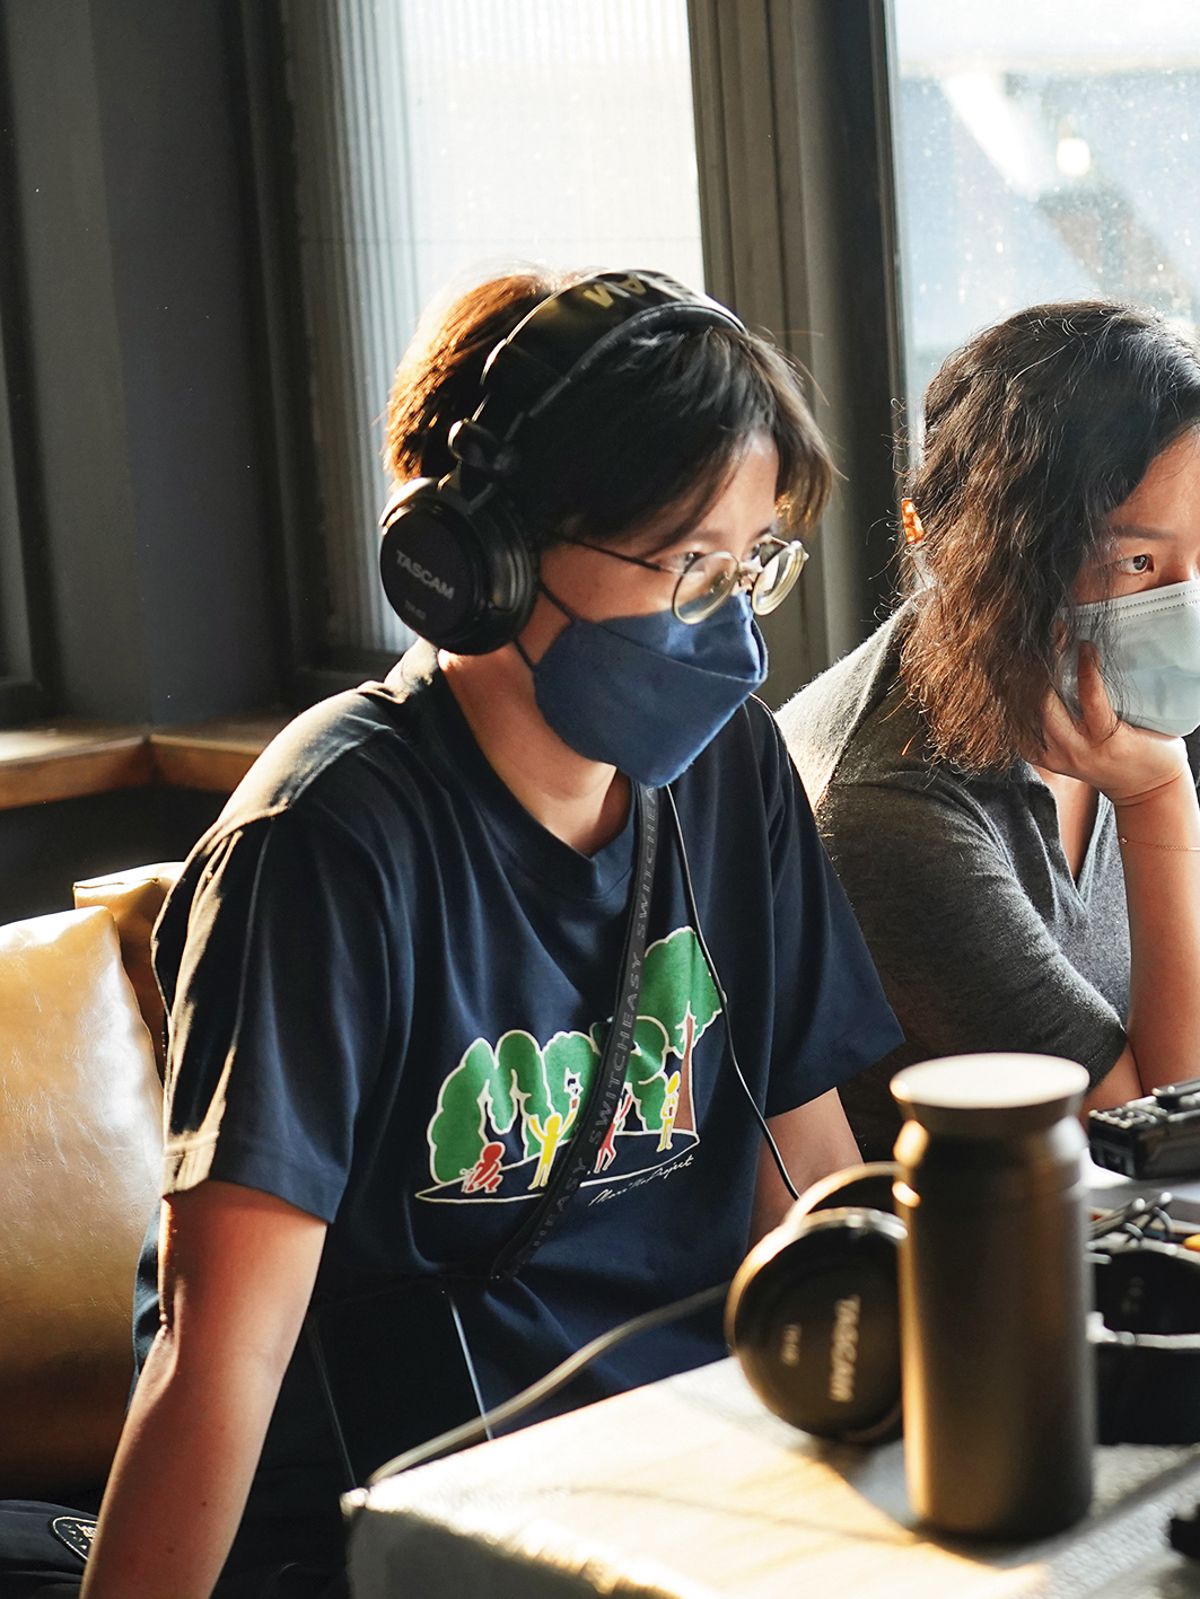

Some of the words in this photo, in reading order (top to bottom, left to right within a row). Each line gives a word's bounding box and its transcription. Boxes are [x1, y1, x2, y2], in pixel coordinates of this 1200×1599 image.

[396, 549, 455, 600] TASCAM
[636, 787, 657, 939] SWITCHEA
[589, 951, 642, 1145] SWITCHEASY
